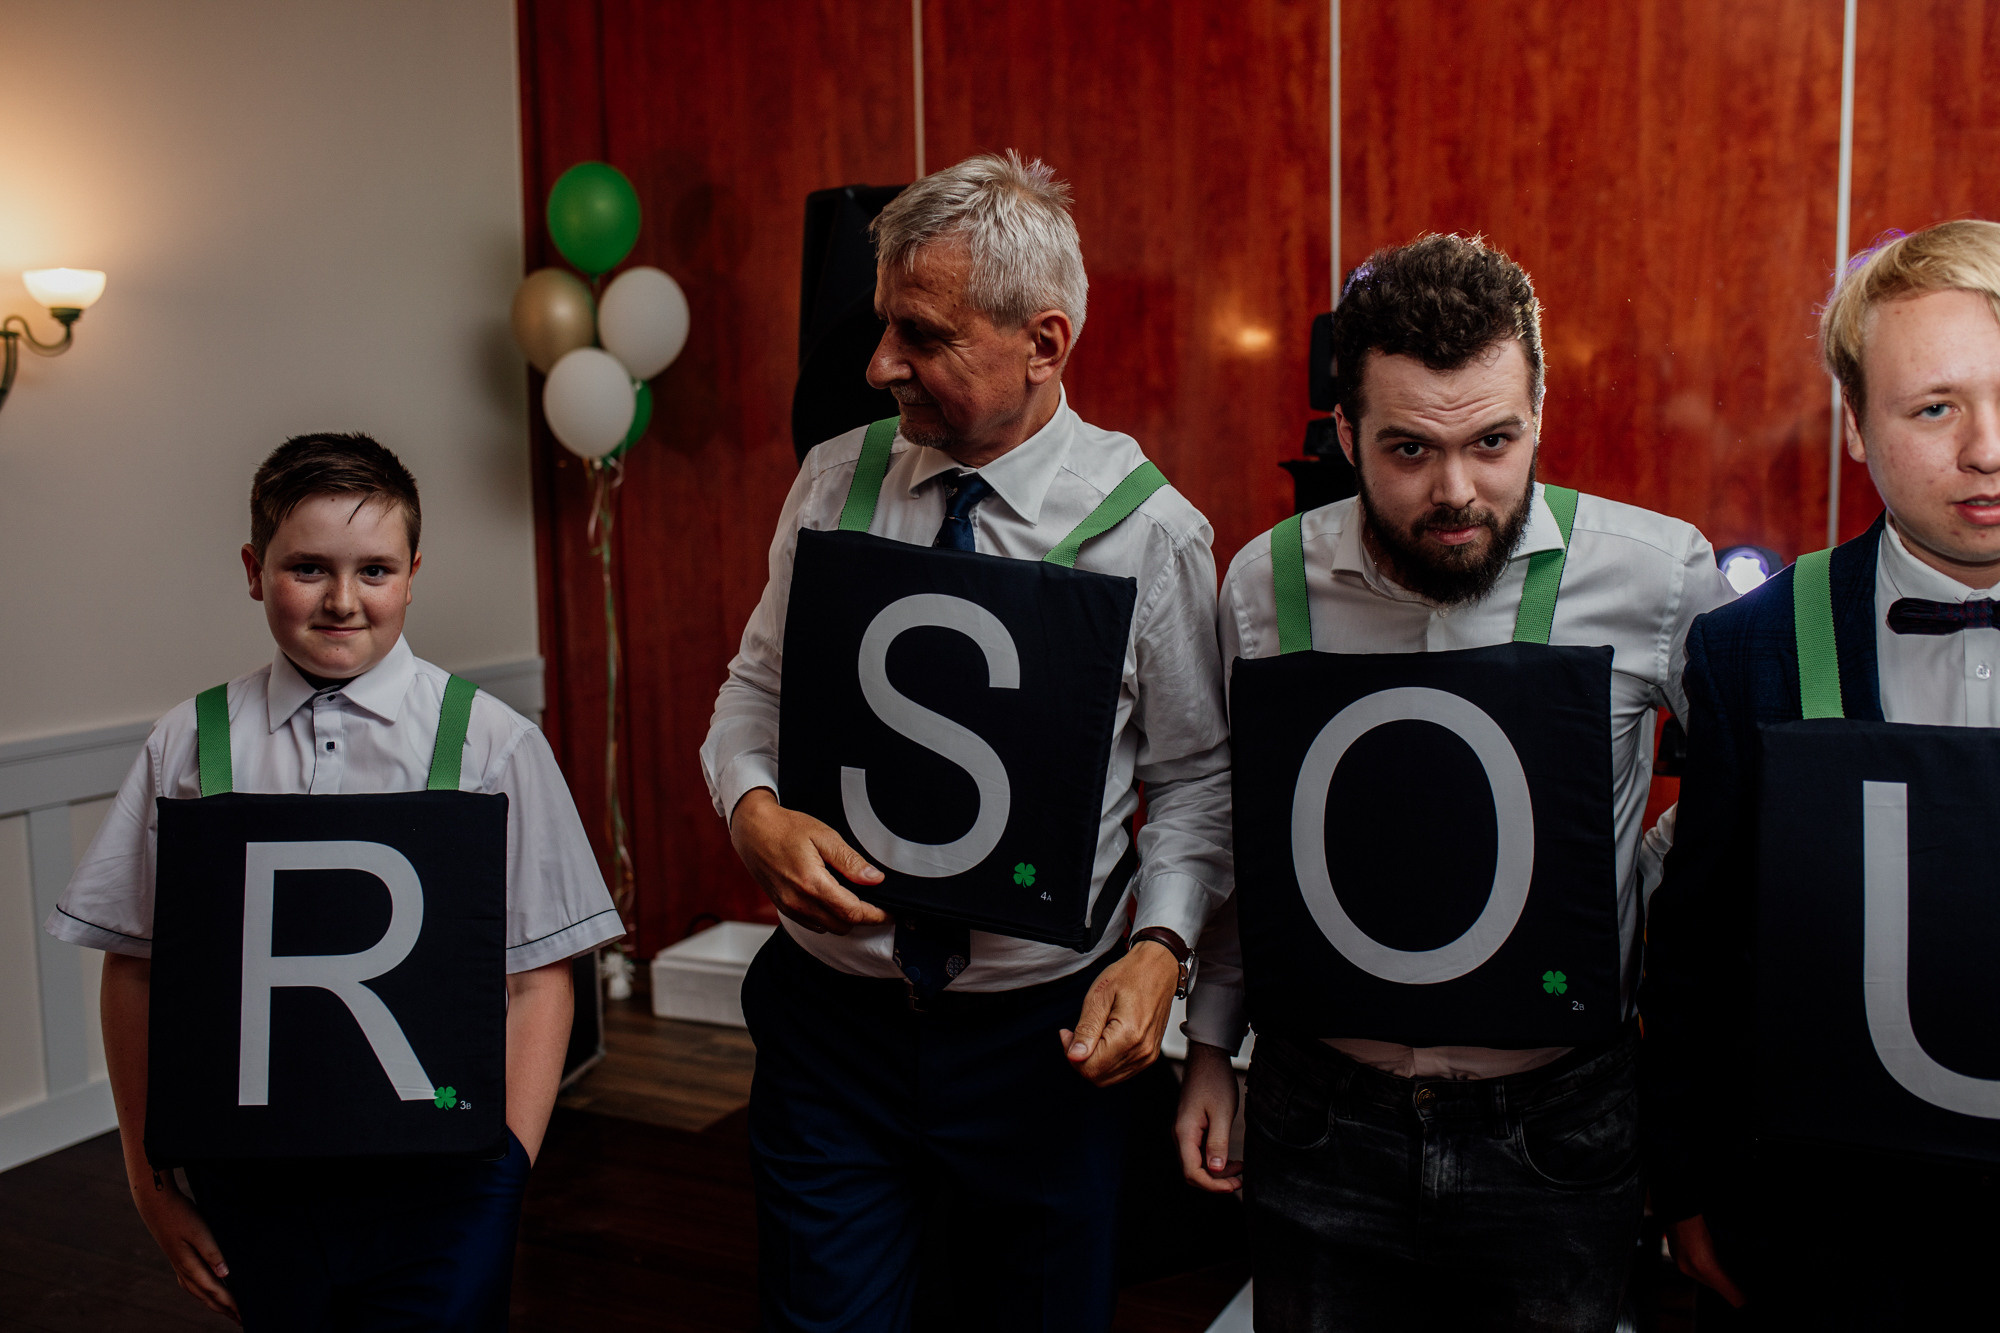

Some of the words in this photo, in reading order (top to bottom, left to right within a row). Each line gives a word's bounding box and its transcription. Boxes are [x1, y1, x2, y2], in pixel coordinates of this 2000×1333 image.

[841, 594, 1020, 878] S
[1291, 687, 1534, 985] O
[238, 841, 438, 1106] R
